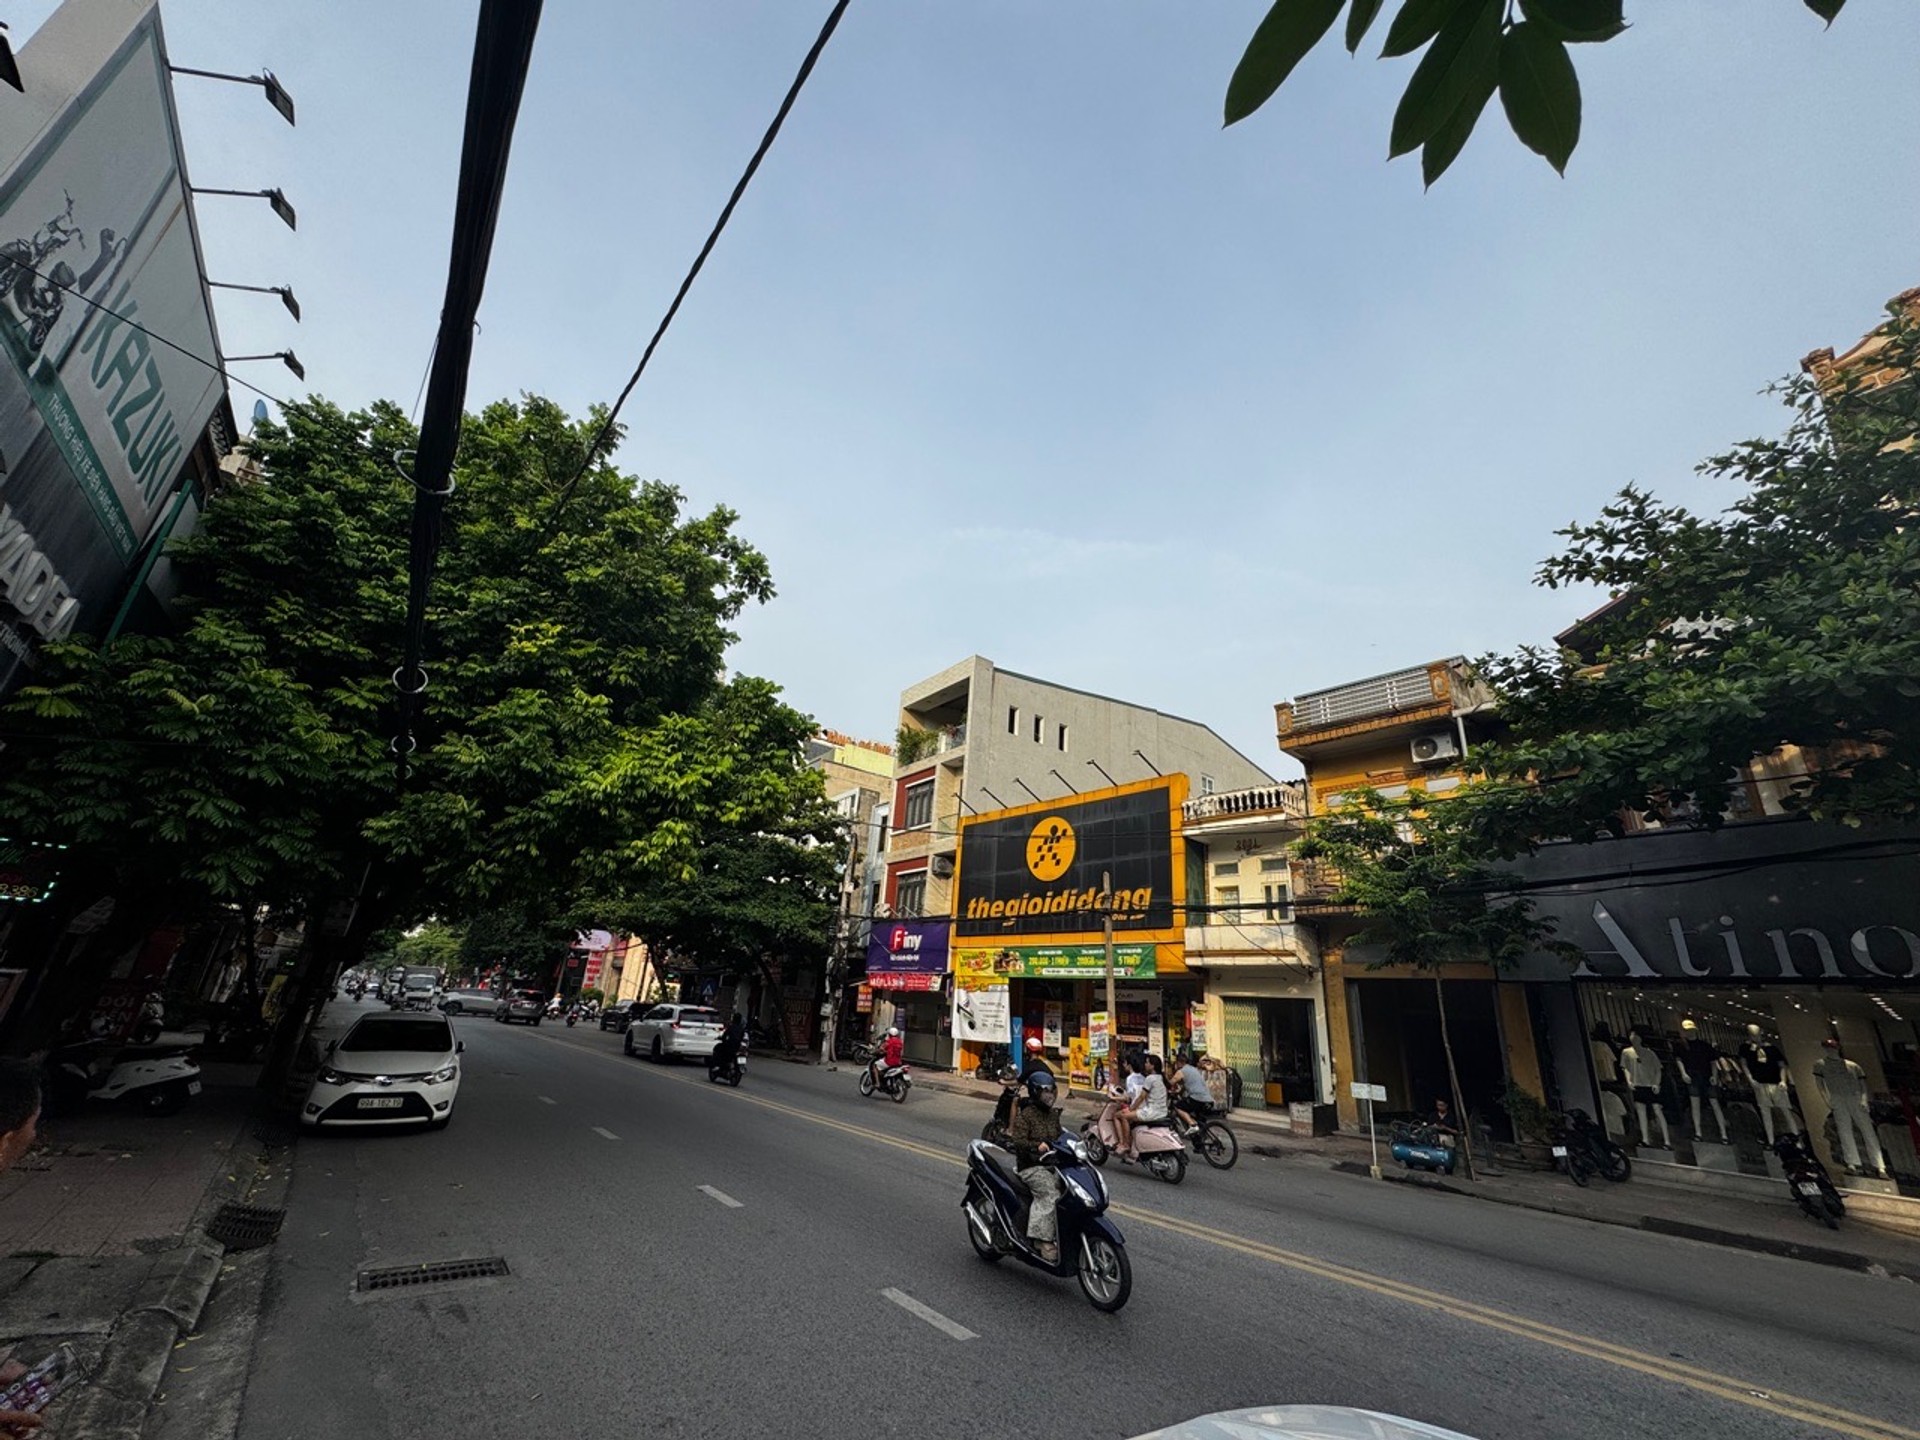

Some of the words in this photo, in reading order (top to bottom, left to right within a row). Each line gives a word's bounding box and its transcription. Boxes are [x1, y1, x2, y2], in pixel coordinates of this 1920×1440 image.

[80, 278, 182, 508] KAZUKI
[966, 886, 1152, 927] thegioididong
[893, 929, 923, 951] Finy
[1571, 899, 1920, 979] Atino
